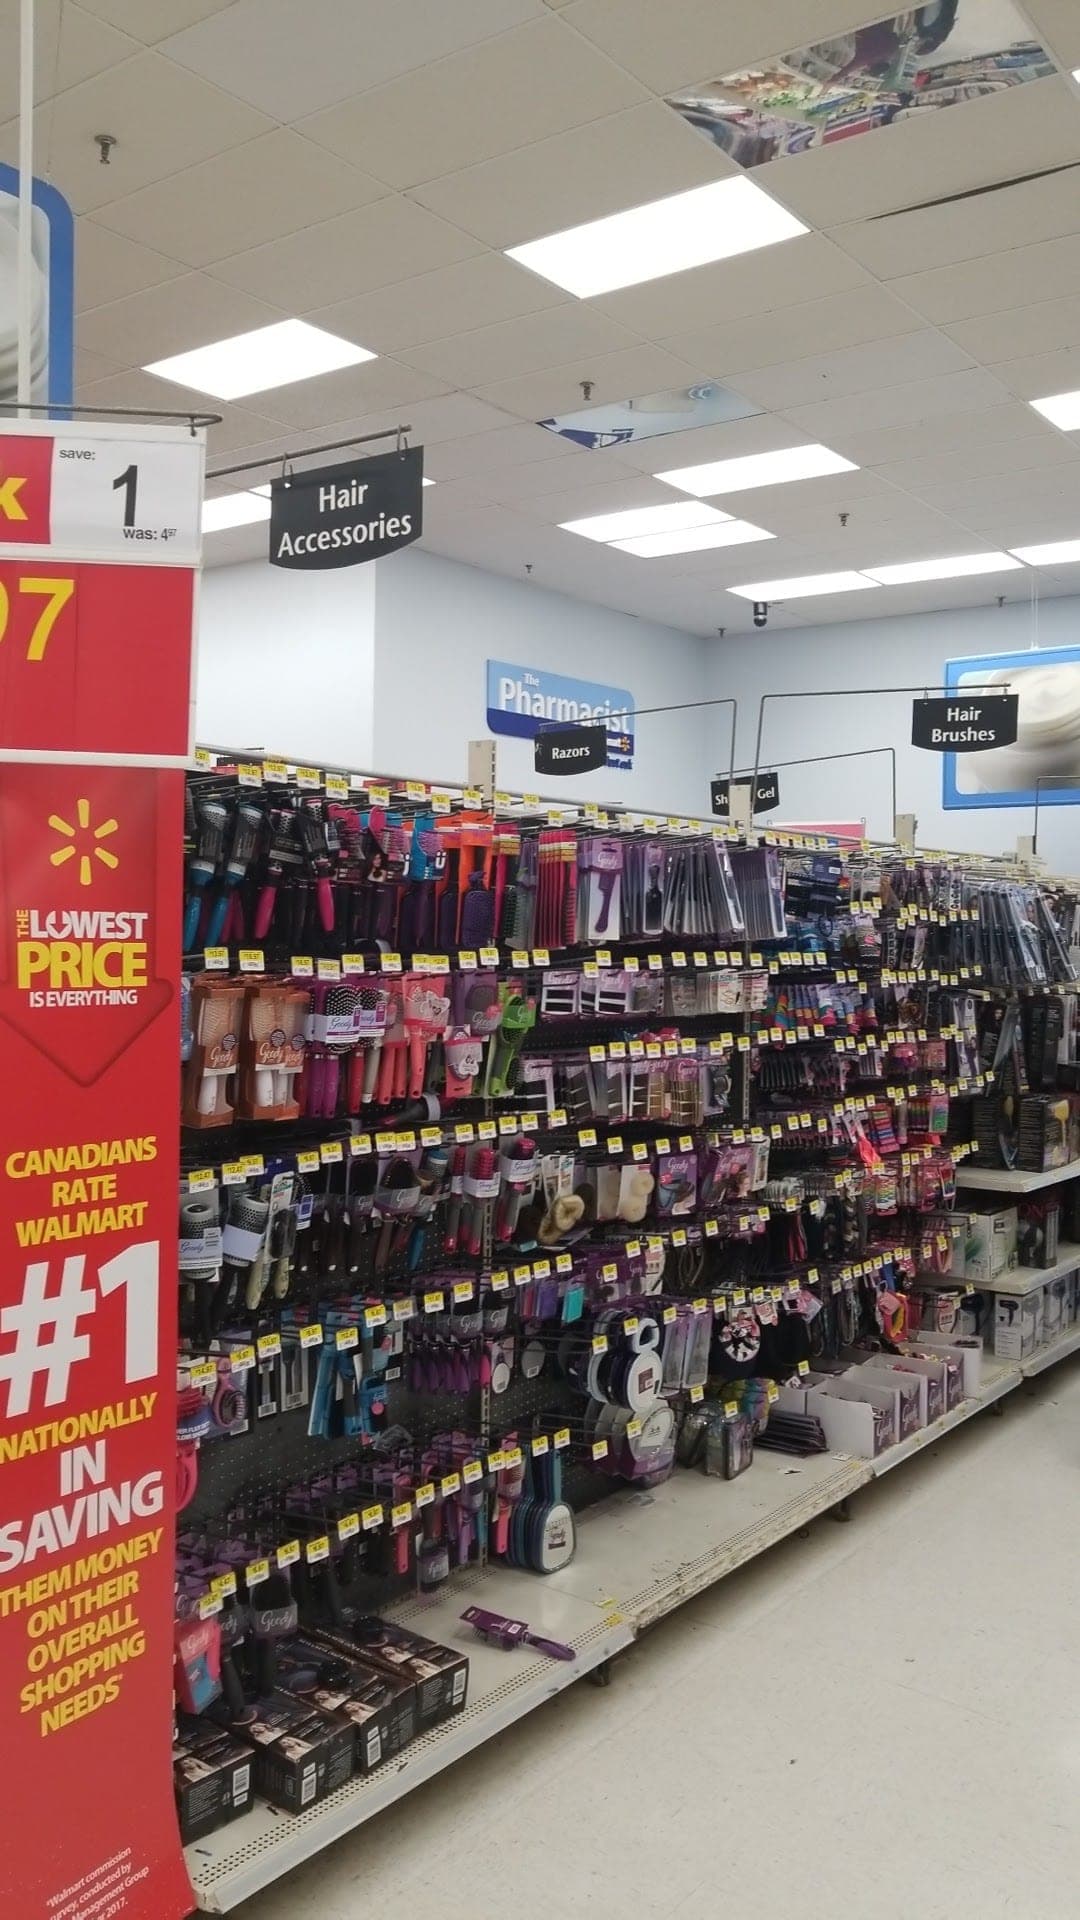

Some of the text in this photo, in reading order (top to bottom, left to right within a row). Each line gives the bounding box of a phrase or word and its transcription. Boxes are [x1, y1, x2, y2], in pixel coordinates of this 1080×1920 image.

[59, 448, 96, 461] save:
[112, 465, 138, 527] 1
[318, 480, 369, 513] Hair
[123, 527, 158, 541] was:
[277, 512, 412, 558] Accessories
[0, 577, 75, 662] 7
[523, 672, 540, 687] The
[499, 676, 631, 734] Pharmacist
[946, 706, 982, 722] Hair
[551, 744, 591, 760] Razors
[931, 727, 996, 743] Brushes
[757, 786, 775, 800] Gel
[16, 909, 29, 937] THE
[30, 909, 148, 940] LOWEST
[17, 941, 148, 989] PRICE
[29, 989, 138, 1008] IS EVERYTHING
[210, 1046, 234, 1067] Goody
[5, 1135, 157, 1179] CANADIANS
[668, 1156, 689, 1174] Goody
[52, 1173, 118, 1208] RATE
[16, 1201, 149, 1248] WALMART
[0, 1239, 160, 1419] #1
[0, 1392, 158, 1465] NATIONALLY
[60, 1438, 107, 1497] IN
[0, 1471, 164, 1573] SAVING
[0, 1528, 164, 1617] THEM MONEY
[27, 1599, 67, 1638] ON
[70, 1570, 139, 1619] THEIR
[261, 1610, 293, 1632] Goody
[27, 1603, 139, 1672] OVERALL
[20, 1631, 146, 1713] SHOPPING
[79, 1867, 121, 1904] conducted
[120, 1862, 132, 1875] by
[125, 1866, 150, 1887] Group
